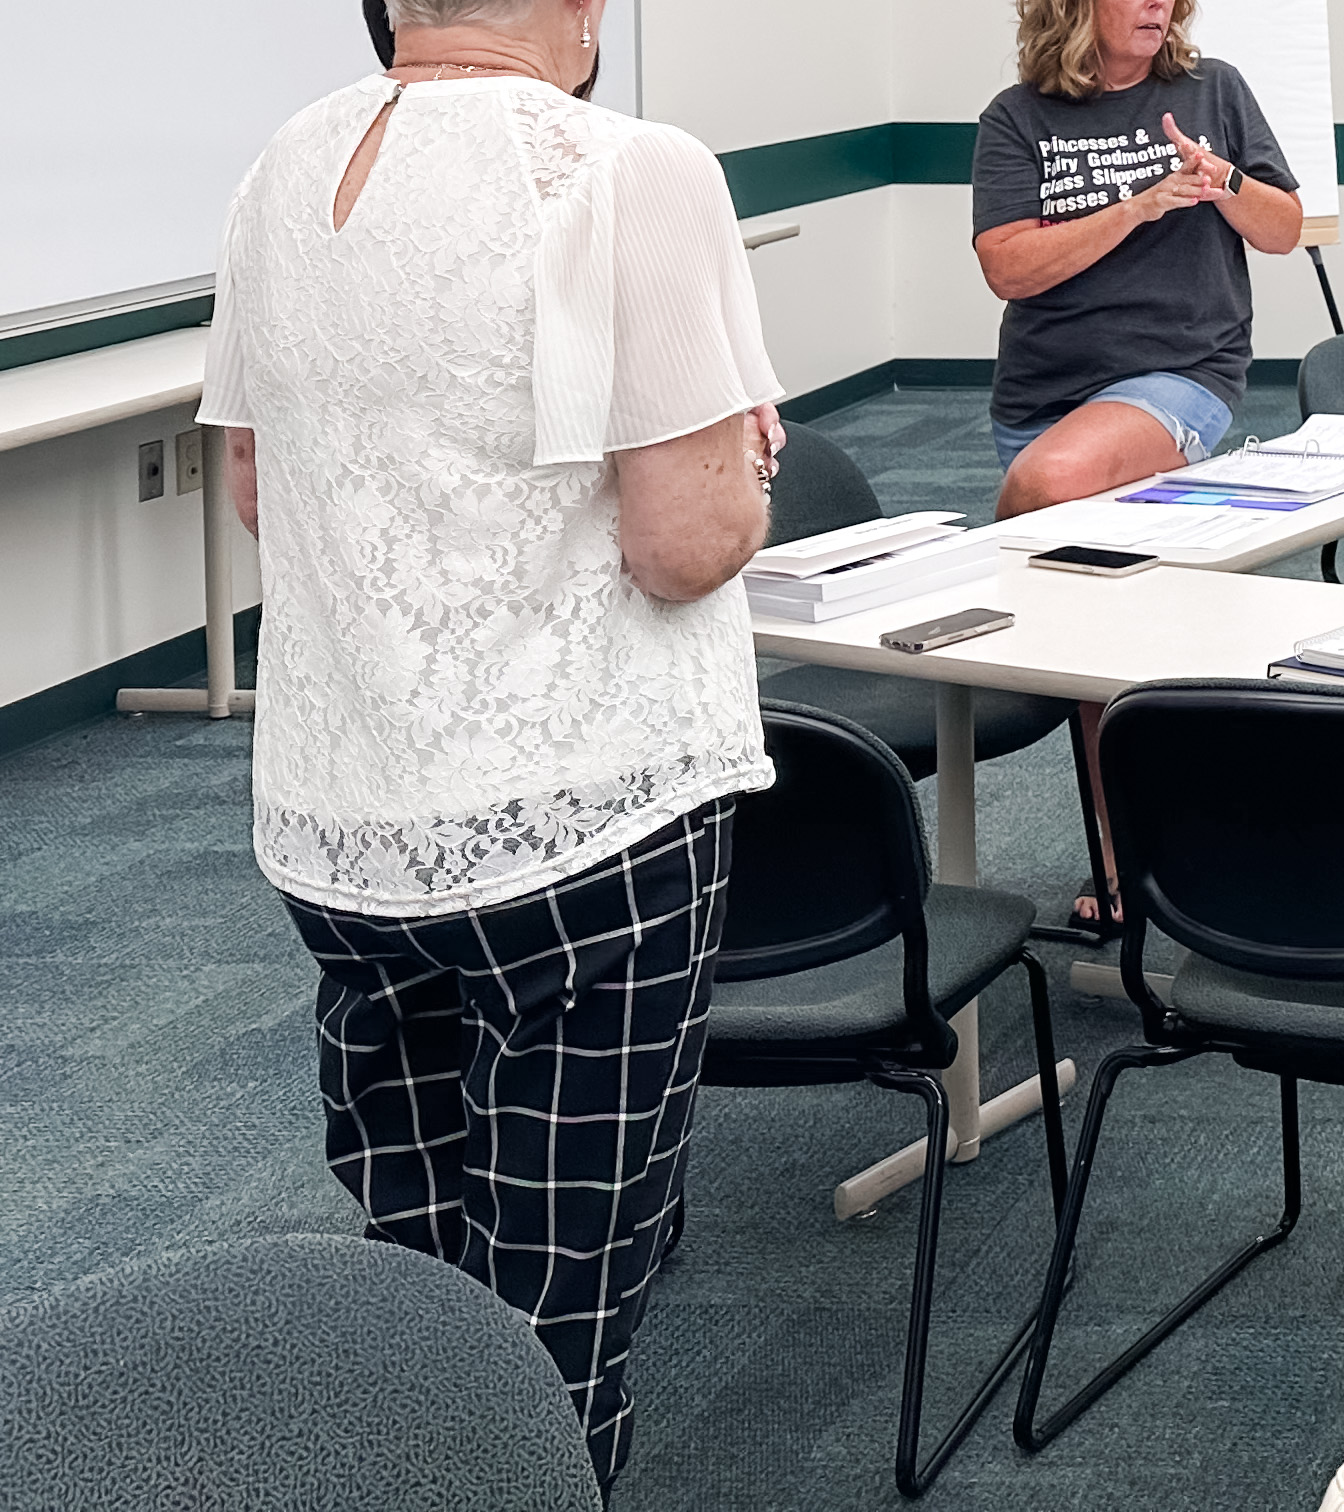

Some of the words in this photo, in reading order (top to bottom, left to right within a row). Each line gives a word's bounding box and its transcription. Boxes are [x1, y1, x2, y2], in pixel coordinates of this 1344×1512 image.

[1038, 134, 1129, 158] Pincesses
[1134, 128, 1150, 145] &
[1087, 143, 1178, 168] Godmothe
[1198, 135, 1213, 152] &
[1039, 174, 1085, 200] Glass
[1091, 163, 1164, 186] Slippers
[1169, 156, 1184, 172] &
[1041, 190, 1109, 216] Dresses
[1118, 184, 1134, 201] &
